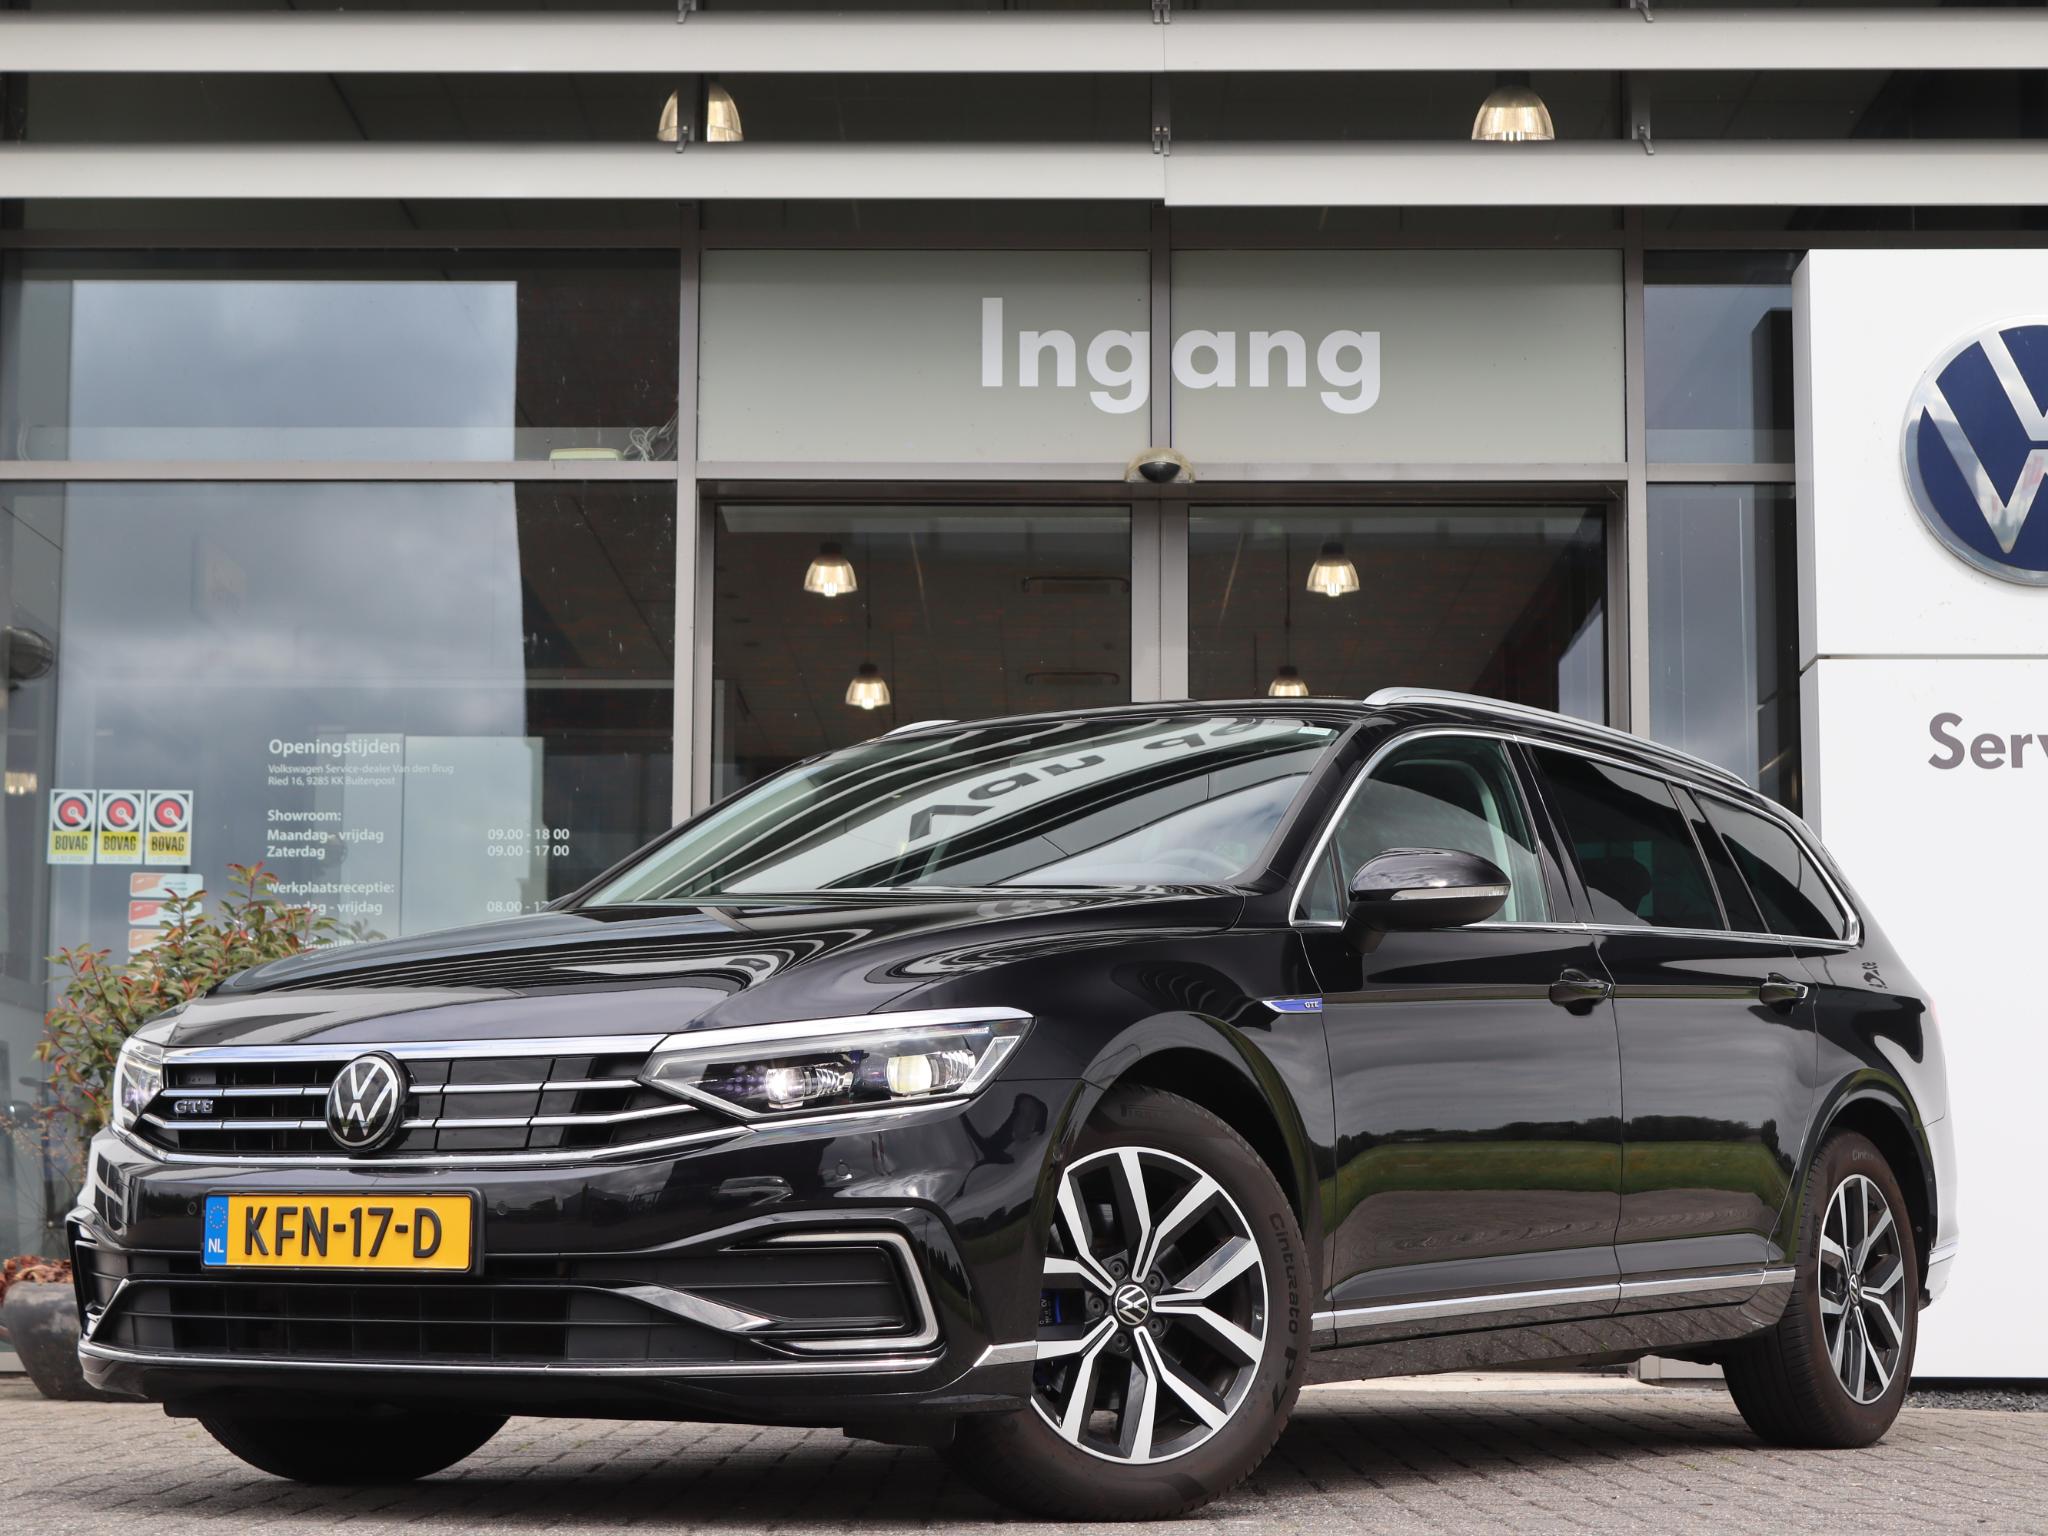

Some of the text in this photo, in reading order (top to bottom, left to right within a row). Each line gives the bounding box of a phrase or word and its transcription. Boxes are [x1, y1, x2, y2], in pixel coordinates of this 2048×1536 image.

[982, 297, 1381, 414] Ingang
[268, 738, 401, 758] Openingstijden
[267, 763, 323, 776] Volkswagen
[393, 763, 410, 774] Van
[267, 775, 289, 786] Ried
[331, 775, 345, 785] KK
[267, 809, 342, 822] Showroom:
[267, 828, 328, 844] Maandag
[339, 828, 385, 844] vrijdag
[487, 828, 524, 841] 09.00
[55, 835, 88, 851] BOVAG
[103, 835, 137, 852] BOVAG
[151, 836, 185, 852] BOVAG
[487, 844, 524, 857] 09.00
[266, 845, 326, 860] Zaterdag
[266, 881, 395, 896] Werkplaatsreceptie:
[337, 900, 384, 916] vrijdag
[486, 900, 523, 913] 08.00
[1304, 1000, 1320, 1009] GTE
[173, 1098, 214, 1115] GTE
[243, 1205, 443, 1259] KFN-17-D
[207, 1237, 225, 1254] NL
